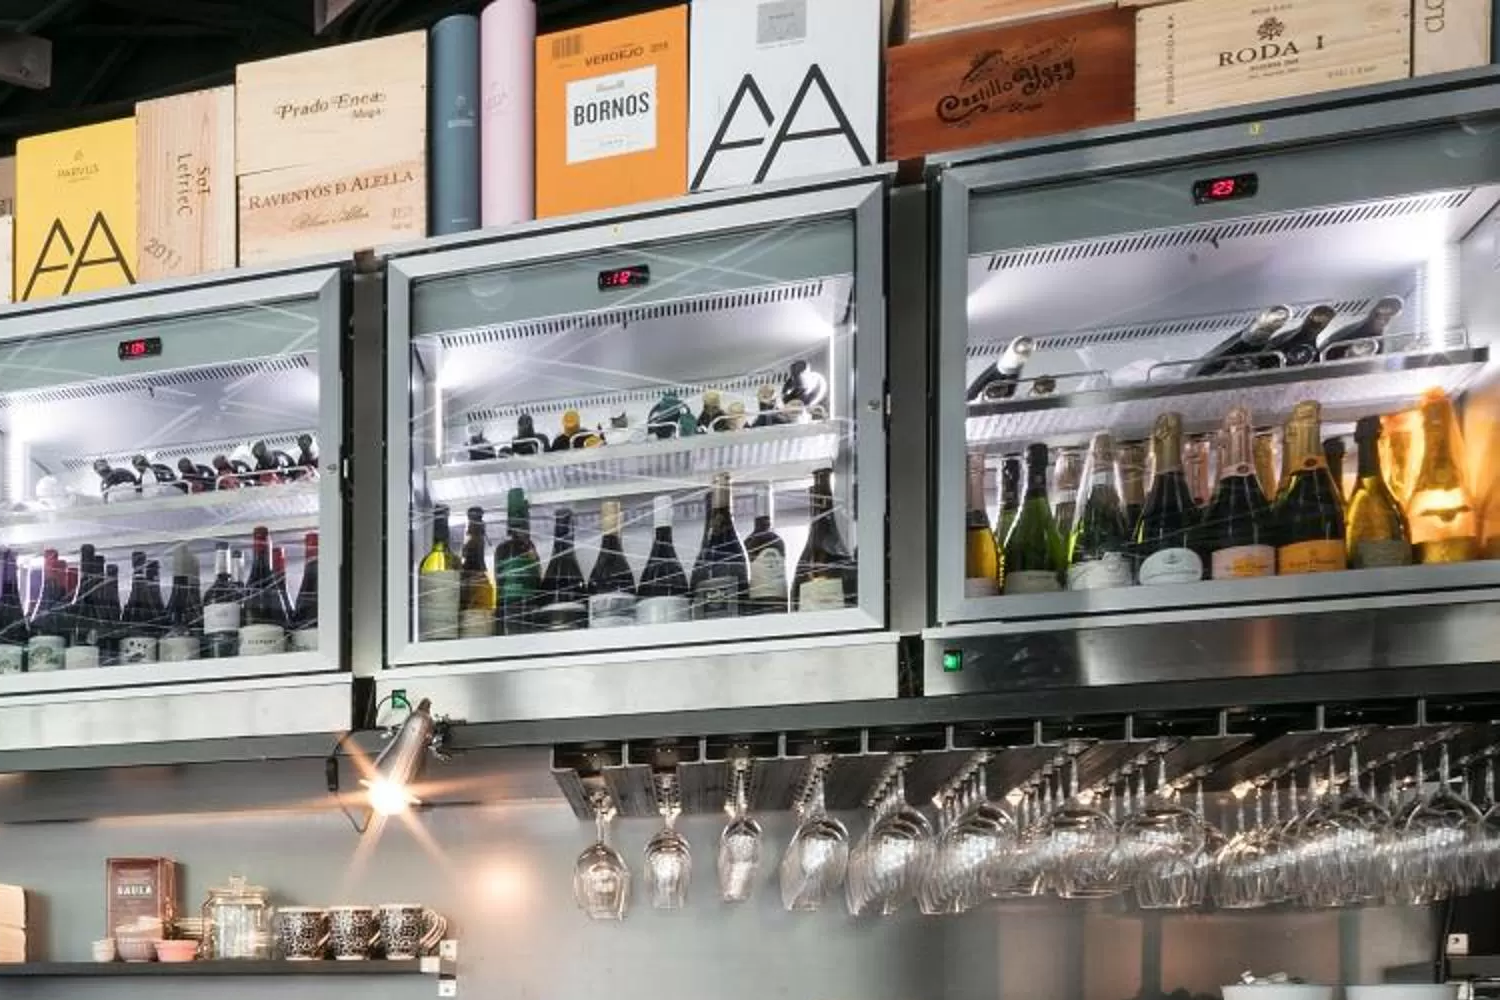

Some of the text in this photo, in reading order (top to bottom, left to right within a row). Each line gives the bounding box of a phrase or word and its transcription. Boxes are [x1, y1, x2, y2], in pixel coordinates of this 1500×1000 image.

[585, 45, 644, 67] VERDEJO
[1219, 40, 1300, 66] RODA
[1316, 35, 1323, 49] I
[274, 97, 329, 120] Prado
[573, 91, 650, 127] BORNOS
